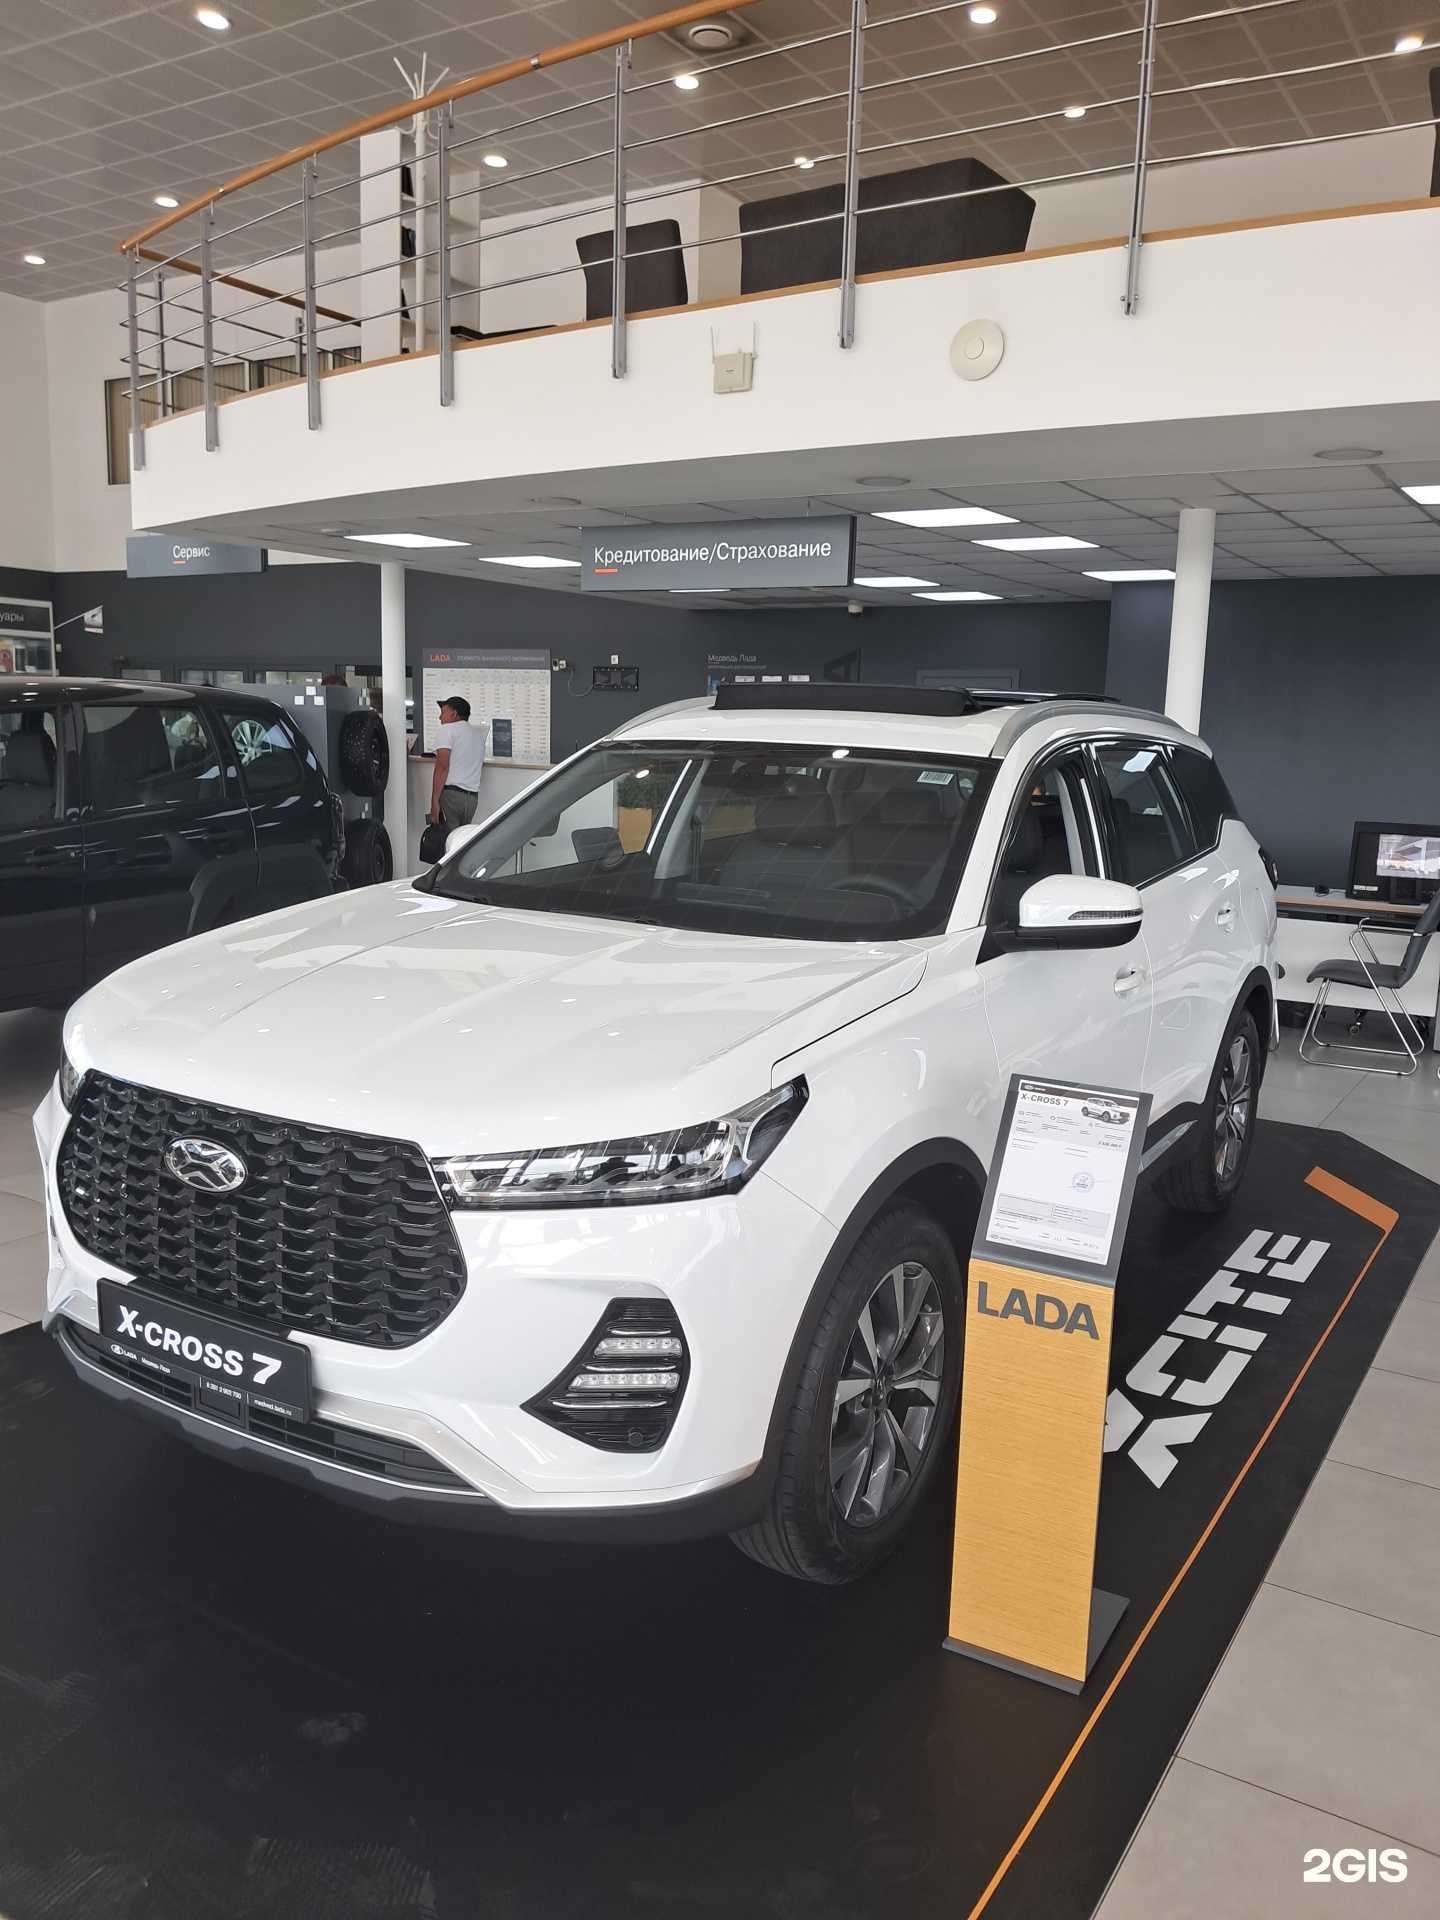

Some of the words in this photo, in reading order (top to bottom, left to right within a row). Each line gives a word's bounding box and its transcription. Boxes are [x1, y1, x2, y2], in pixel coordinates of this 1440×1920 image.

[172, 544, 211, 560] Сервис
[594, 542, 831, 566] Кредитование/Страхование
[430, 653, 450, 663] LADA
[1020, 1093, 1061, 1106] X-CROSS
[1063, 1099, 1069, 1107] 7
[977, 1280, 1100, 1341] LADA
[116, 1304, 244, 1377] X-CROSS
[252, 1352, 283, 1385] 7
